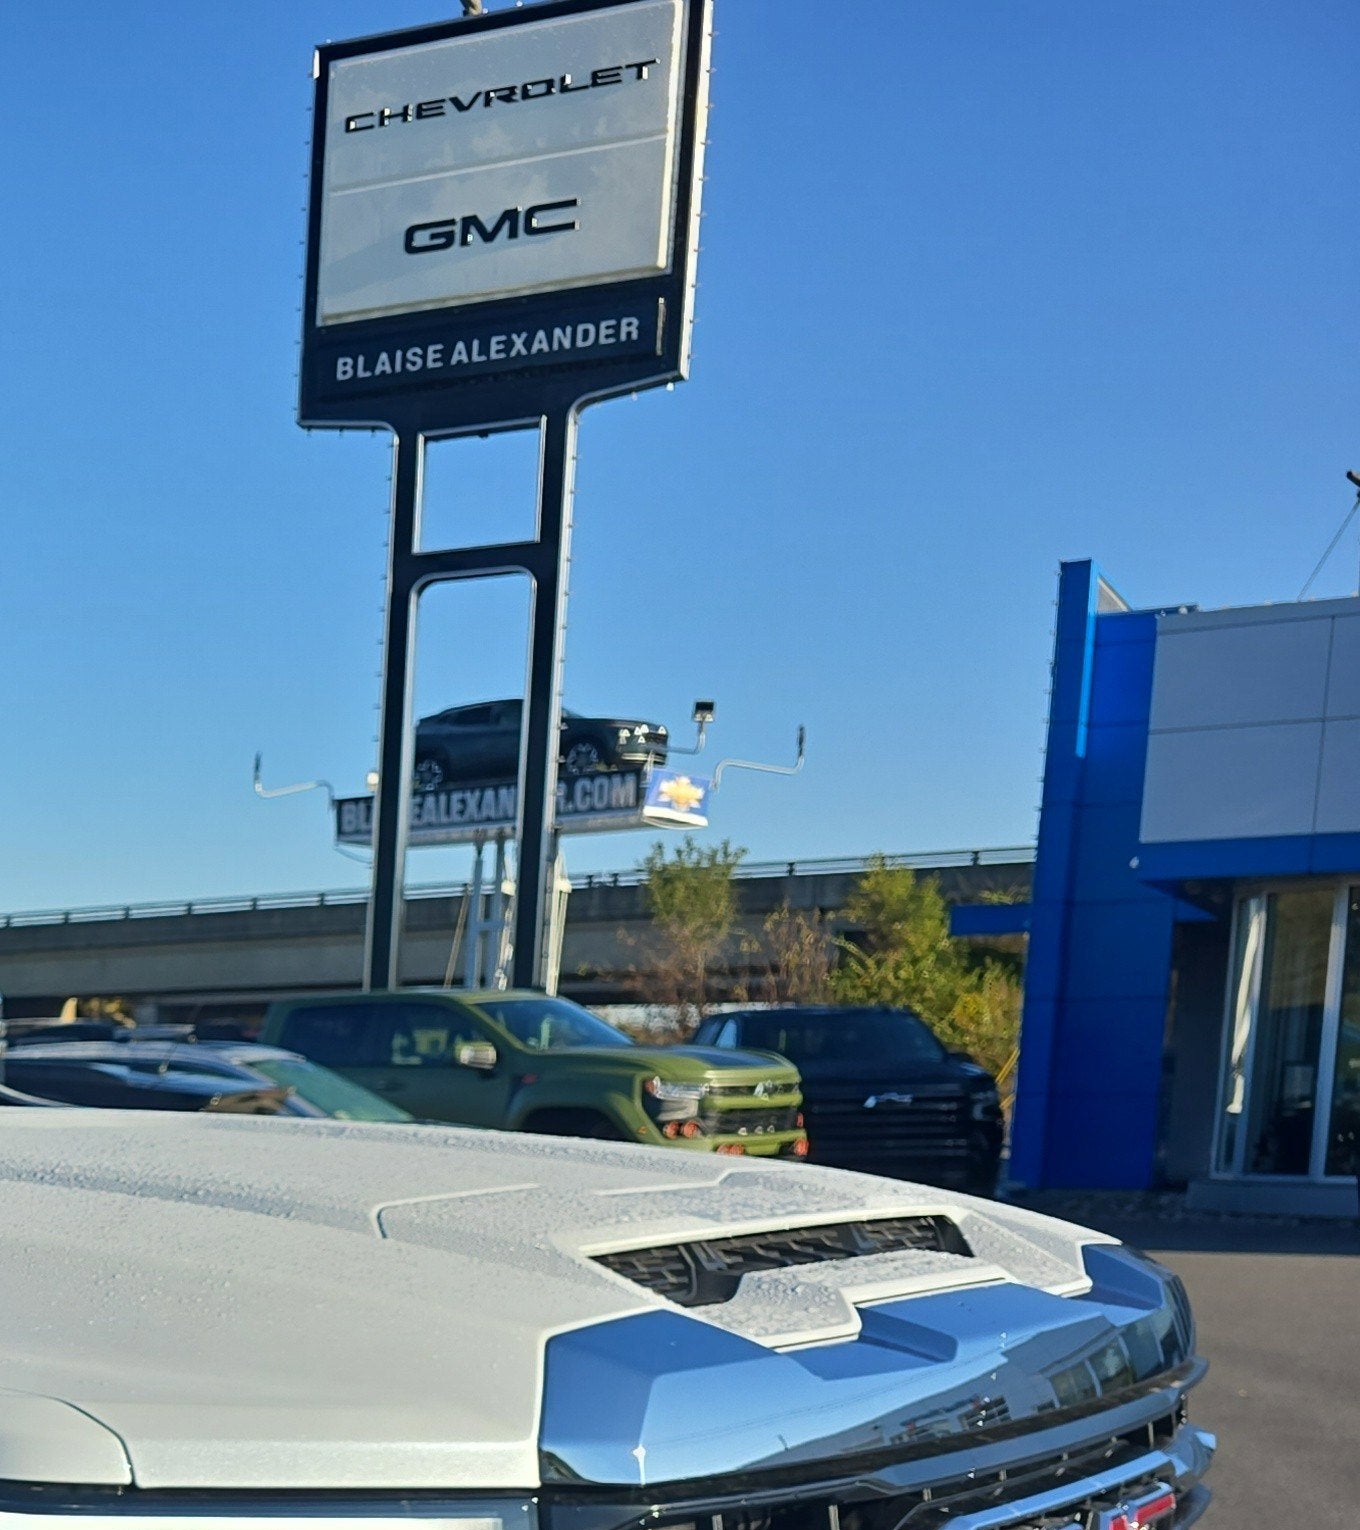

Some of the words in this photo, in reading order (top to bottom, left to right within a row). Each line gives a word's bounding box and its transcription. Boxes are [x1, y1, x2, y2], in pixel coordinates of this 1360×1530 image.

[344, 58, 662, 134] CHEVROLET
[404, 198, 581, 255] GMC
[335, 344, 444, 382] BLAISE
[450, 316, 641, 364] ALEXANDER
[339, 774, 637, 835] BLEALEXANR.COM
